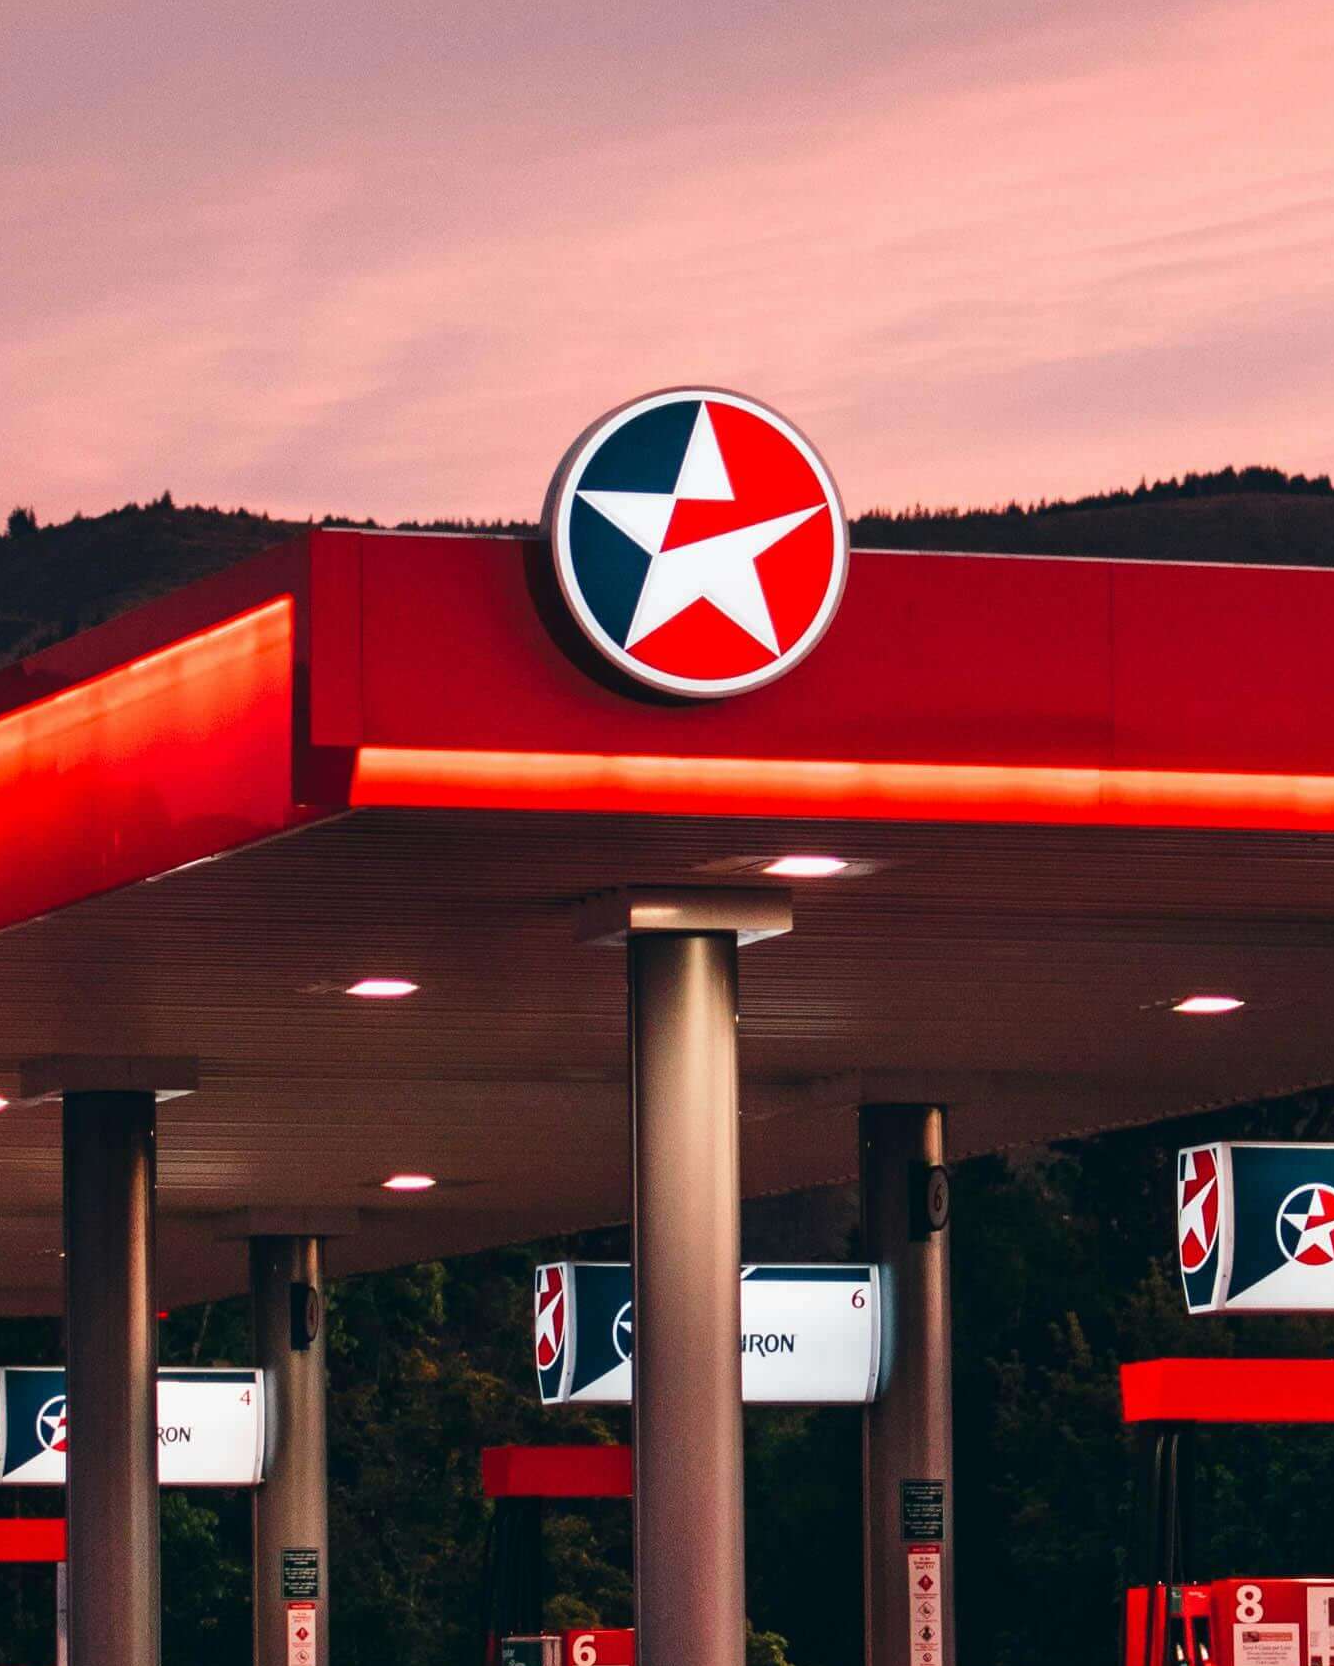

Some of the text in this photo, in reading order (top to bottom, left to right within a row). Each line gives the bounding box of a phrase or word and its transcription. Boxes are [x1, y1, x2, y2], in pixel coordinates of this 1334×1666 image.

[850, 1287, 866, 1309] 6
[239, 1389, 252, 1406] 4
[1235, 1584, 1264, 1624] 8
[572, 1634, 597, 1666] 6
